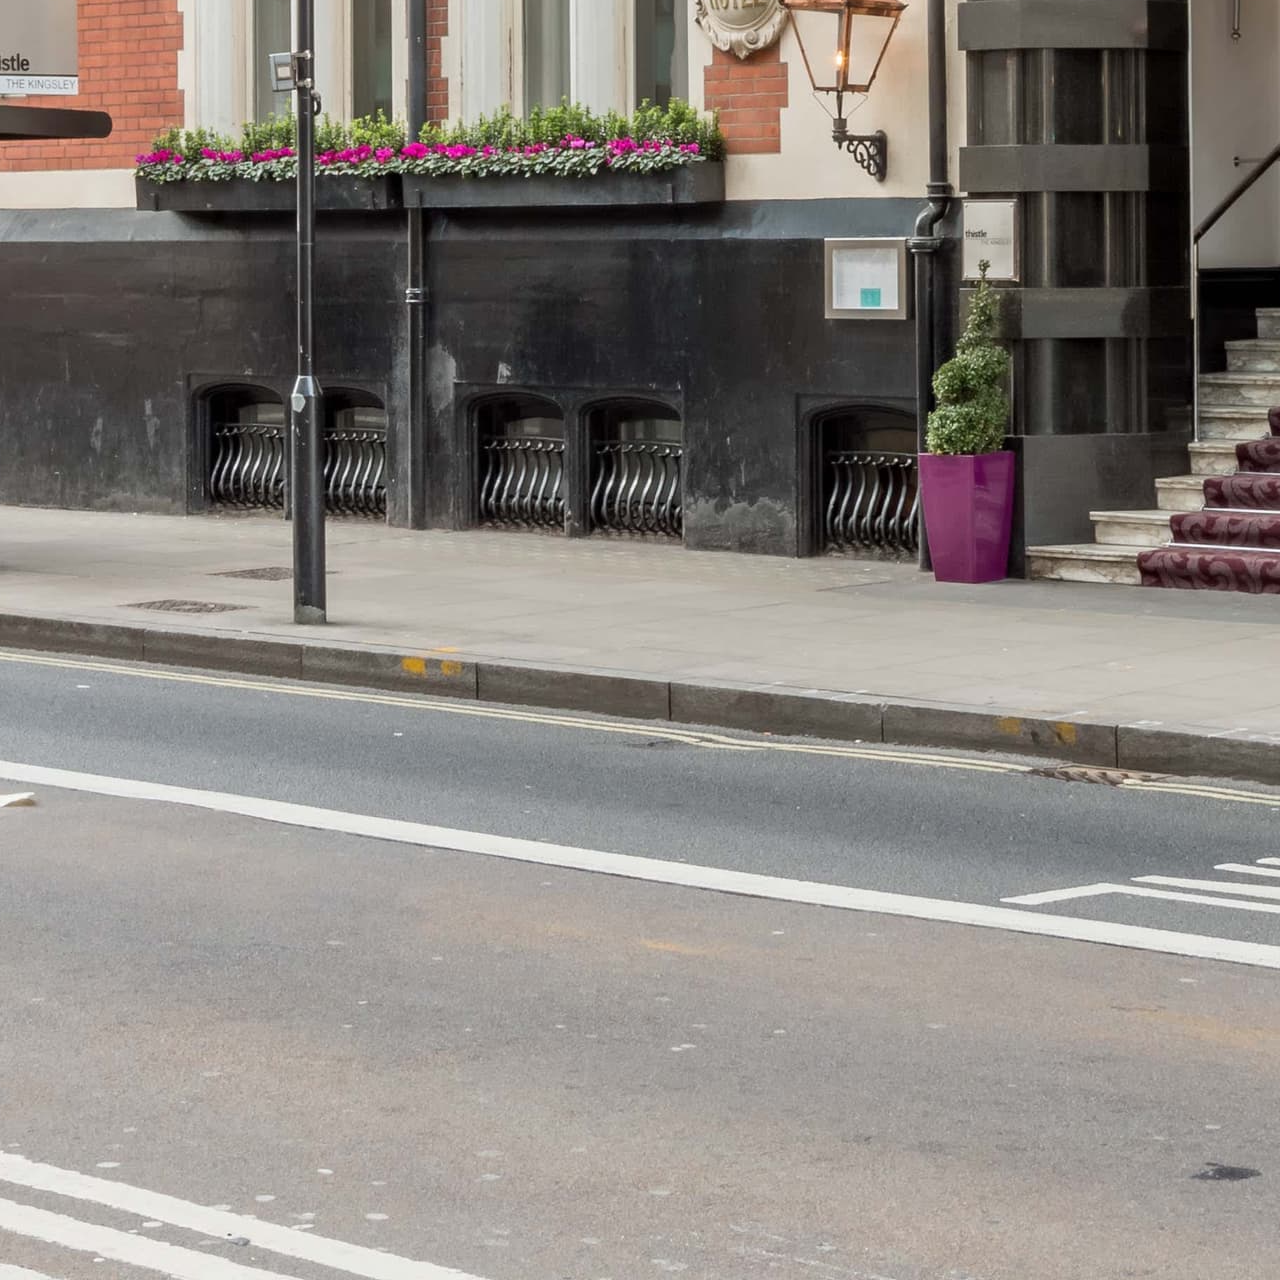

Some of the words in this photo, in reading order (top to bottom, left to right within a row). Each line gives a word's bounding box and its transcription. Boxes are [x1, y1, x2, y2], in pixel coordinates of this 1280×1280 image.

[6, 78, 25, 89] THE
[28, 79, 76, 90] KINGSLEY
[965, 229, 987, 238] thistle
